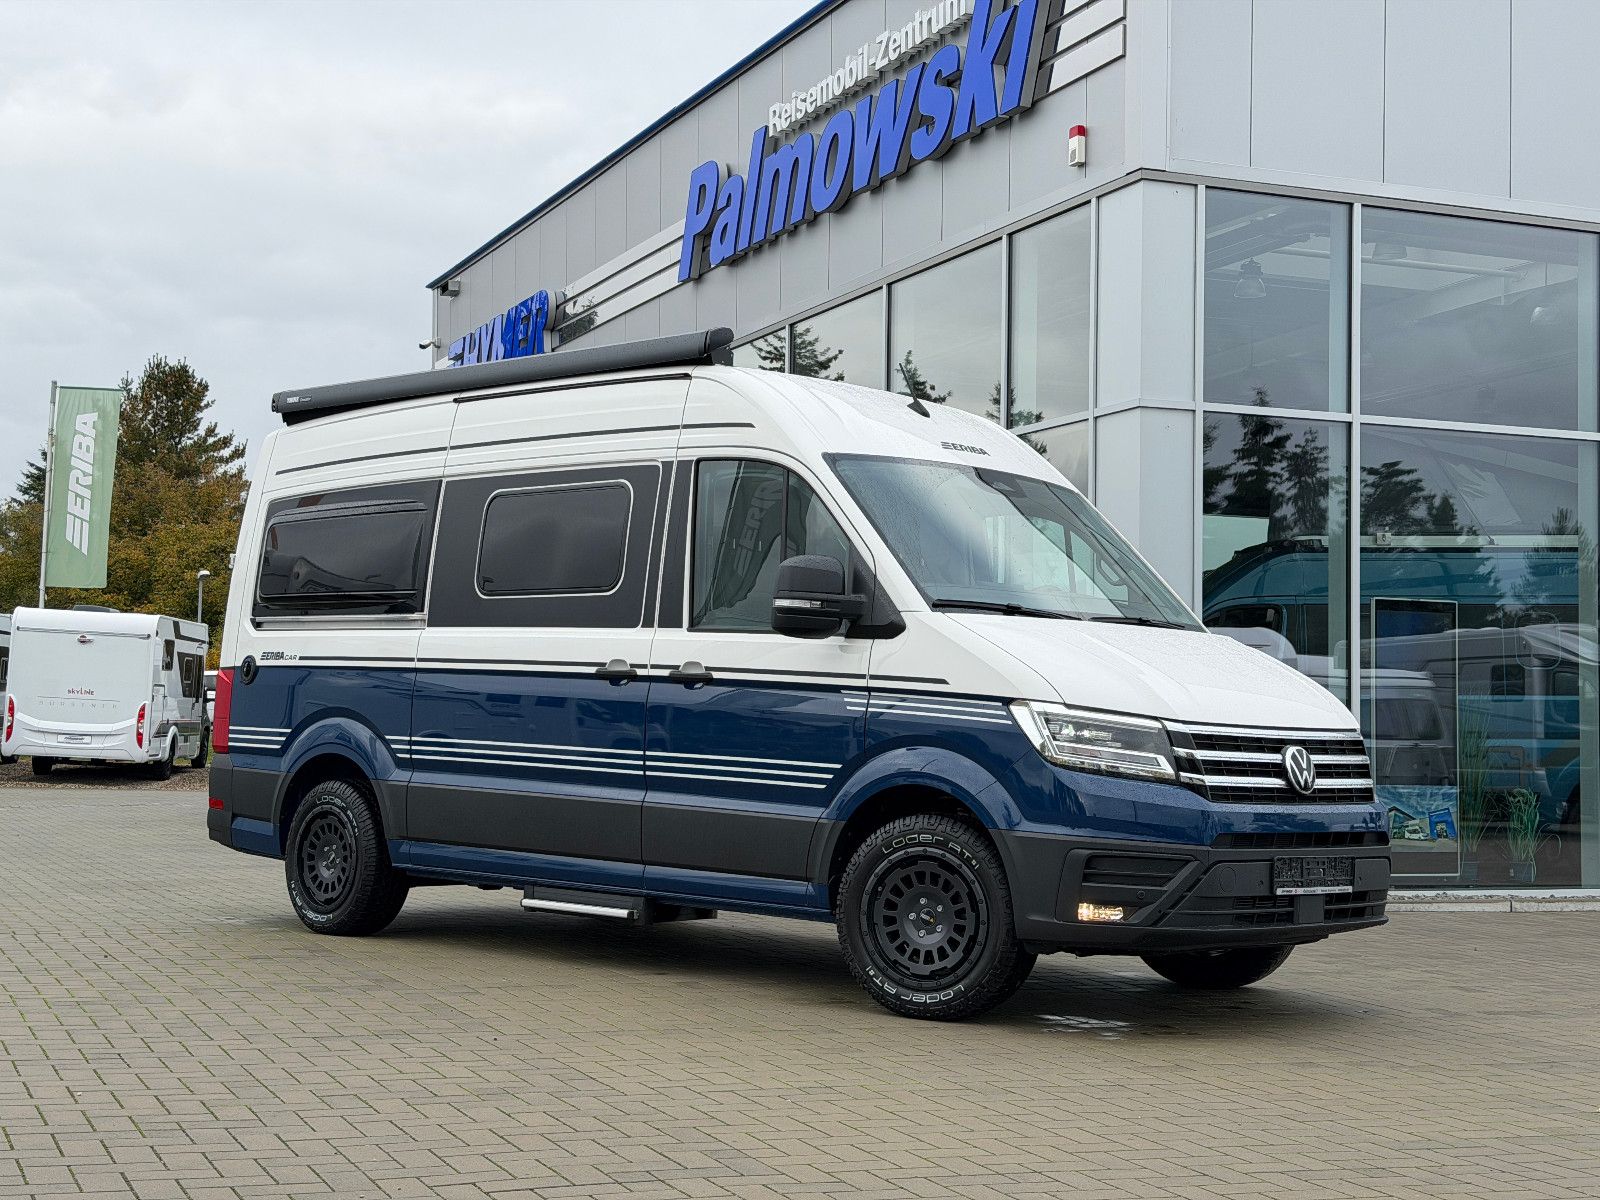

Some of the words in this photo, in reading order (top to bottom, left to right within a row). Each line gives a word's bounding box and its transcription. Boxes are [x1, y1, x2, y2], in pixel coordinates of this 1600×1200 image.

[768, 0, 967, 137] Reisemobil-Zentrum
[678, 0, 1037, 283] Palmowski
[66, 411, 99, 556] ERIBA
[940, 441, 991, 456] ERIBA
[260, 651, 285, 660] ERIBA
